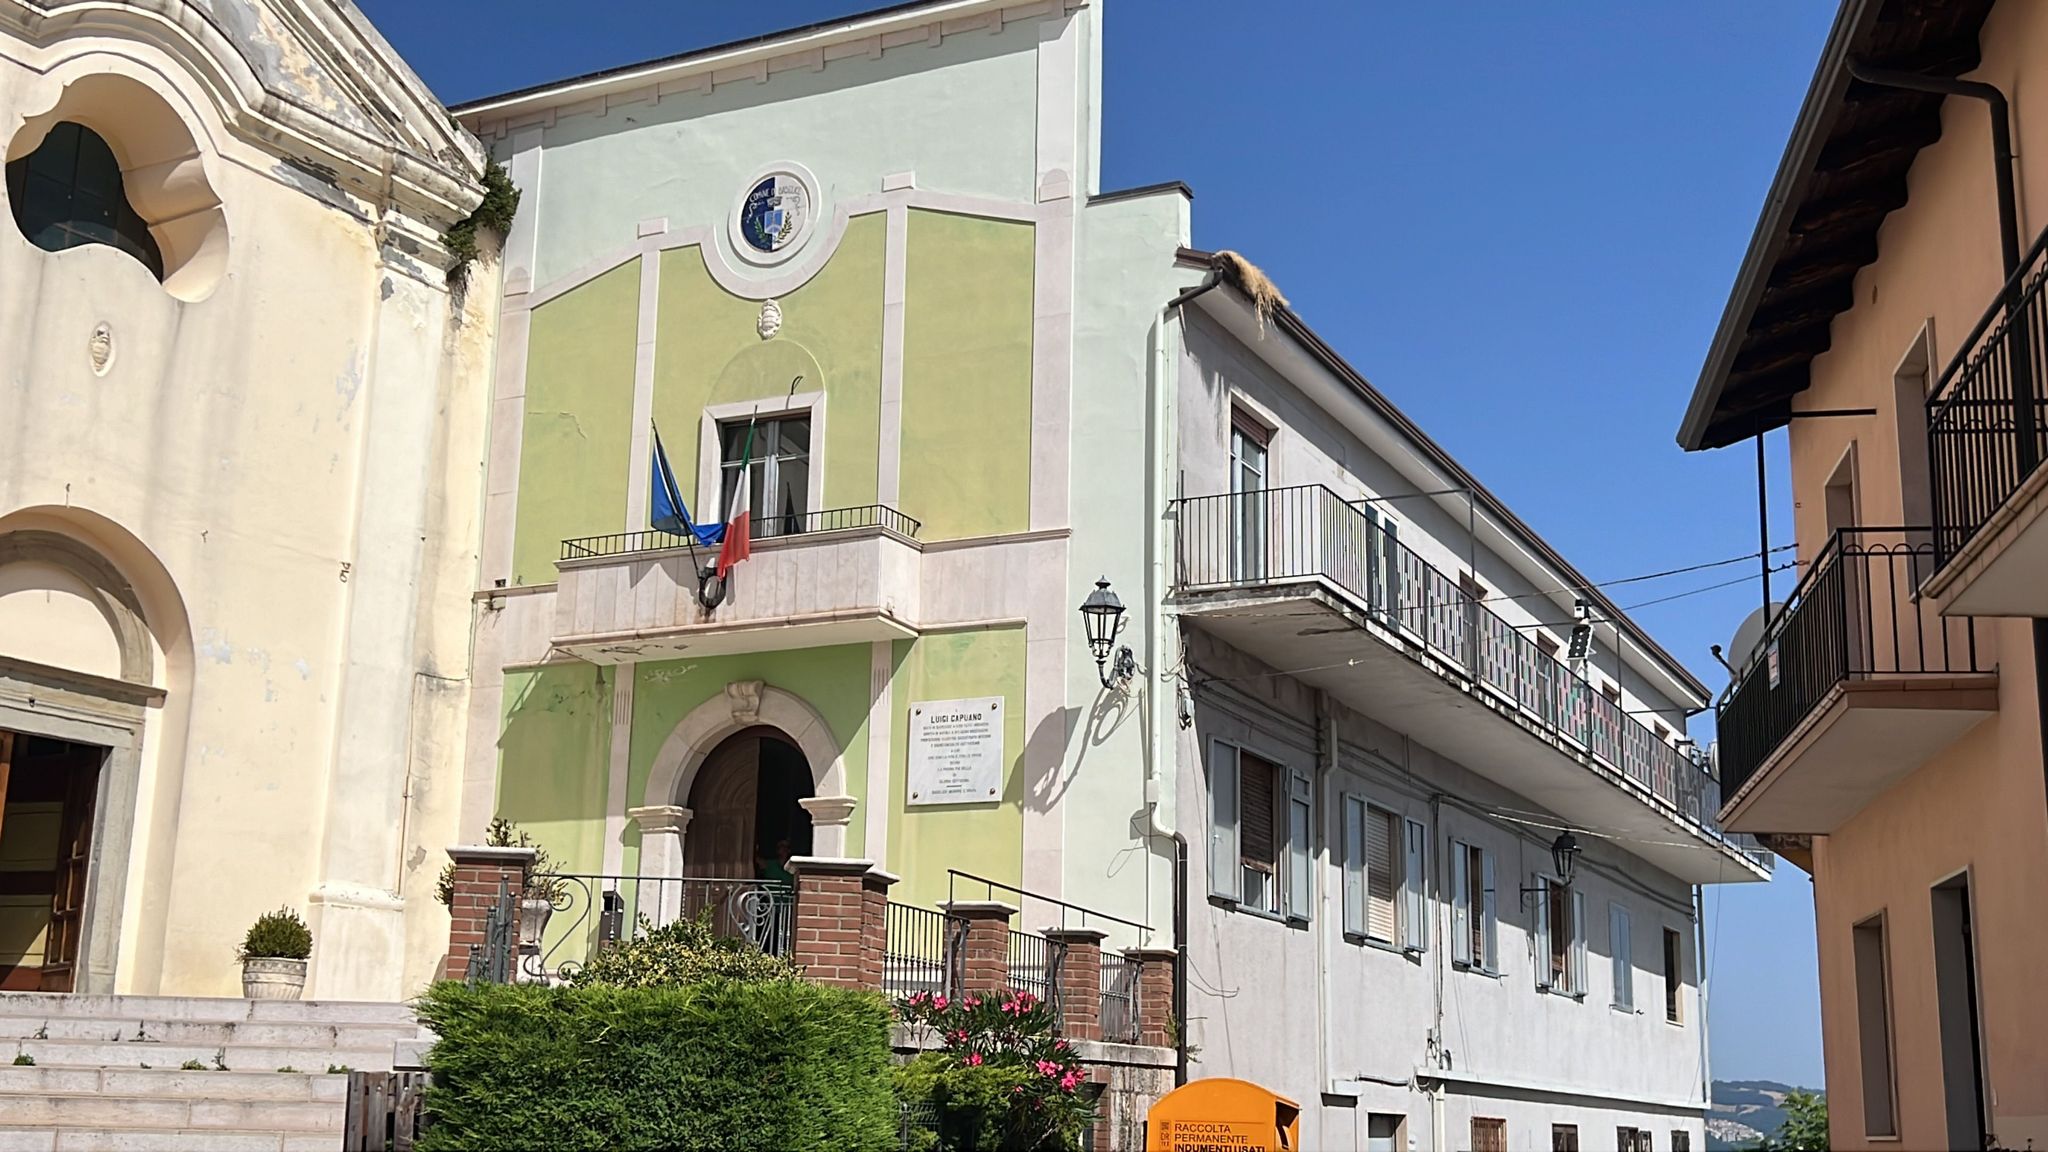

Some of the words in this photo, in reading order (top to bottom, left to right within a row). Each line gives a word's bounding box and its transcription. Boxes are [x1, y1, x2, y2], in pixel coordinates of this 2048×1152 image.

[930, 715, 949, 724] LUIGI
[950, 713, 982, 723] CAPUANO
[1174, 1123, 1231, 1133] RACCOLTA
[1174, 1133, 1248, 1144] PERMANENTE
[1174, 1143, 1232, 1152] INDUMENTI
